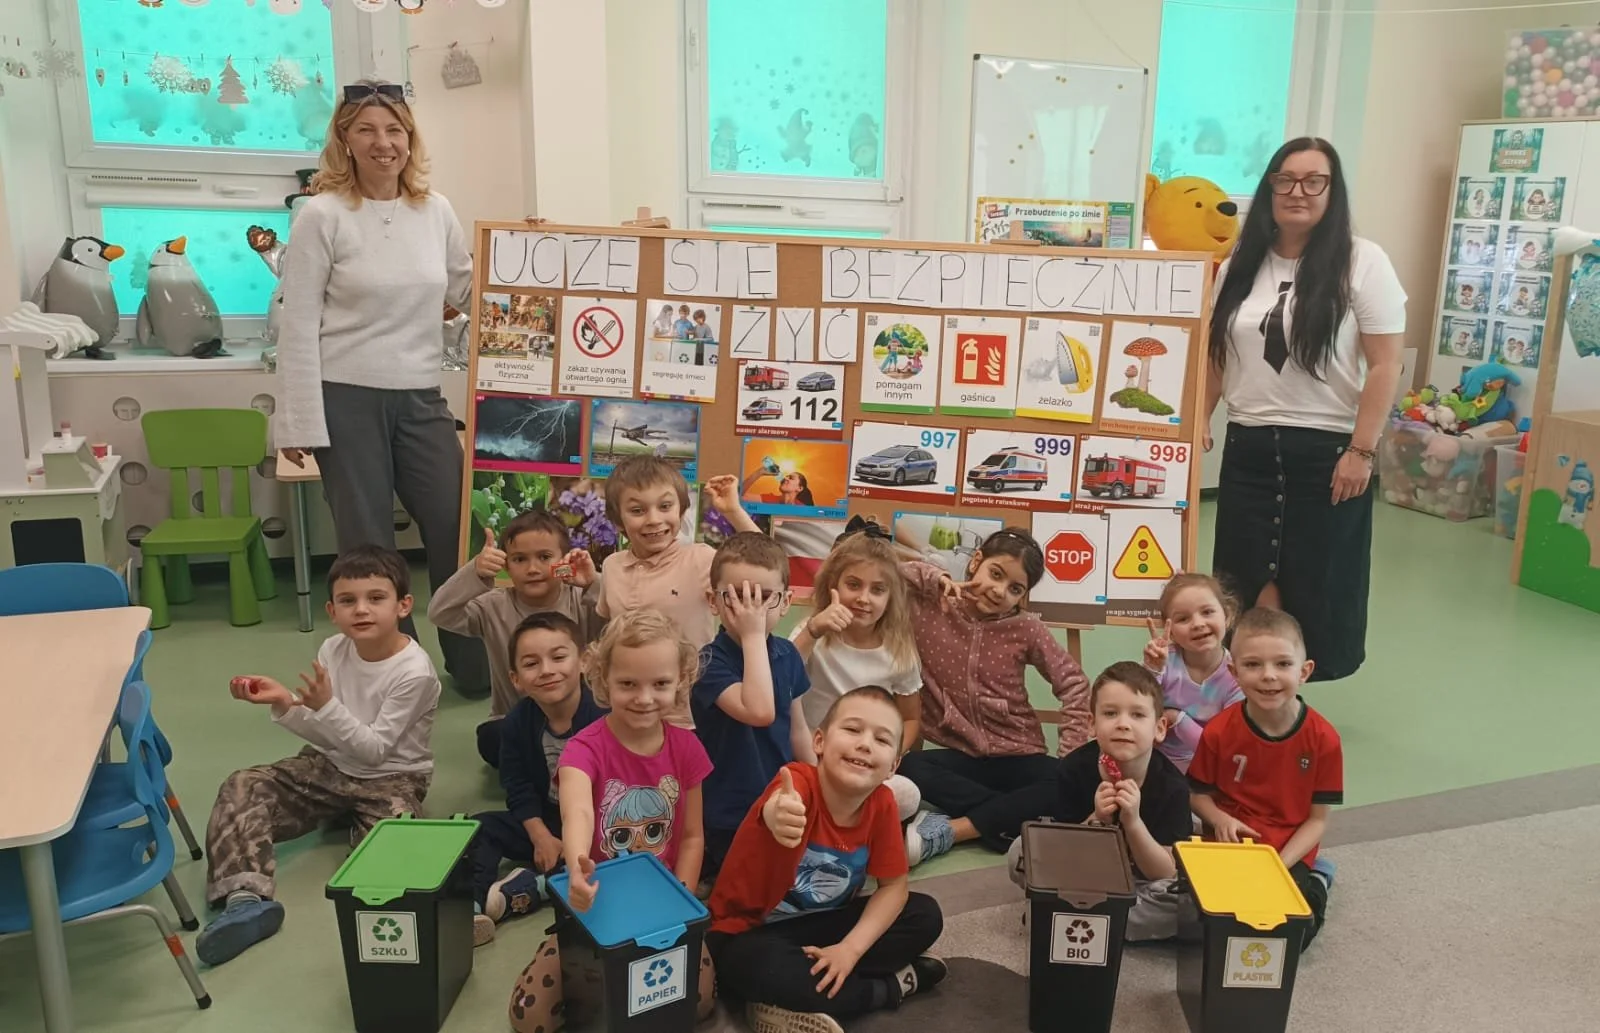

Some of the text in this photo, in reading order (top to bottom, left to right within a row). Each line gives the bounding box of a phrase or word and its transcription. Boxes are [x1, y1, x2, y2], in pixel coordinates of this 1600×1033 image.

[1014, 207, 1068, 218] Przebudzenie
[1068, 209, 1080, 219] po
[1081, 210, 1101, 219] zimie
[493, 236, 1196, 314] UCZĘ SIĘ BEZPIECZNIE
[494, 361, 535, 371] aktywność
[498, 370, 529, 379] fizyczna
[565, 374, 627, 385] otwartego ognia
[875, 380, 922, 391] pomagam
[884, 389, 913, 400] innym
[960, 392, 996, 404] gaśnica
[790, 396, 838, 421] 112
[920, 430, 957, 449] 997
[1034, 437, 1072, 456] 999
[1149, 444, 1187, 464] 998
[1048, 549, 1092, 566] STOP
[1232, 754, 1248, 782] 7
[370, 947, 408, 957] SZKŁO
[1066, 947, 1091, 960] BIO
[1232, 971, 1274, 982] PLASTIK
[638, 985, 678, 1007] PAPIER
